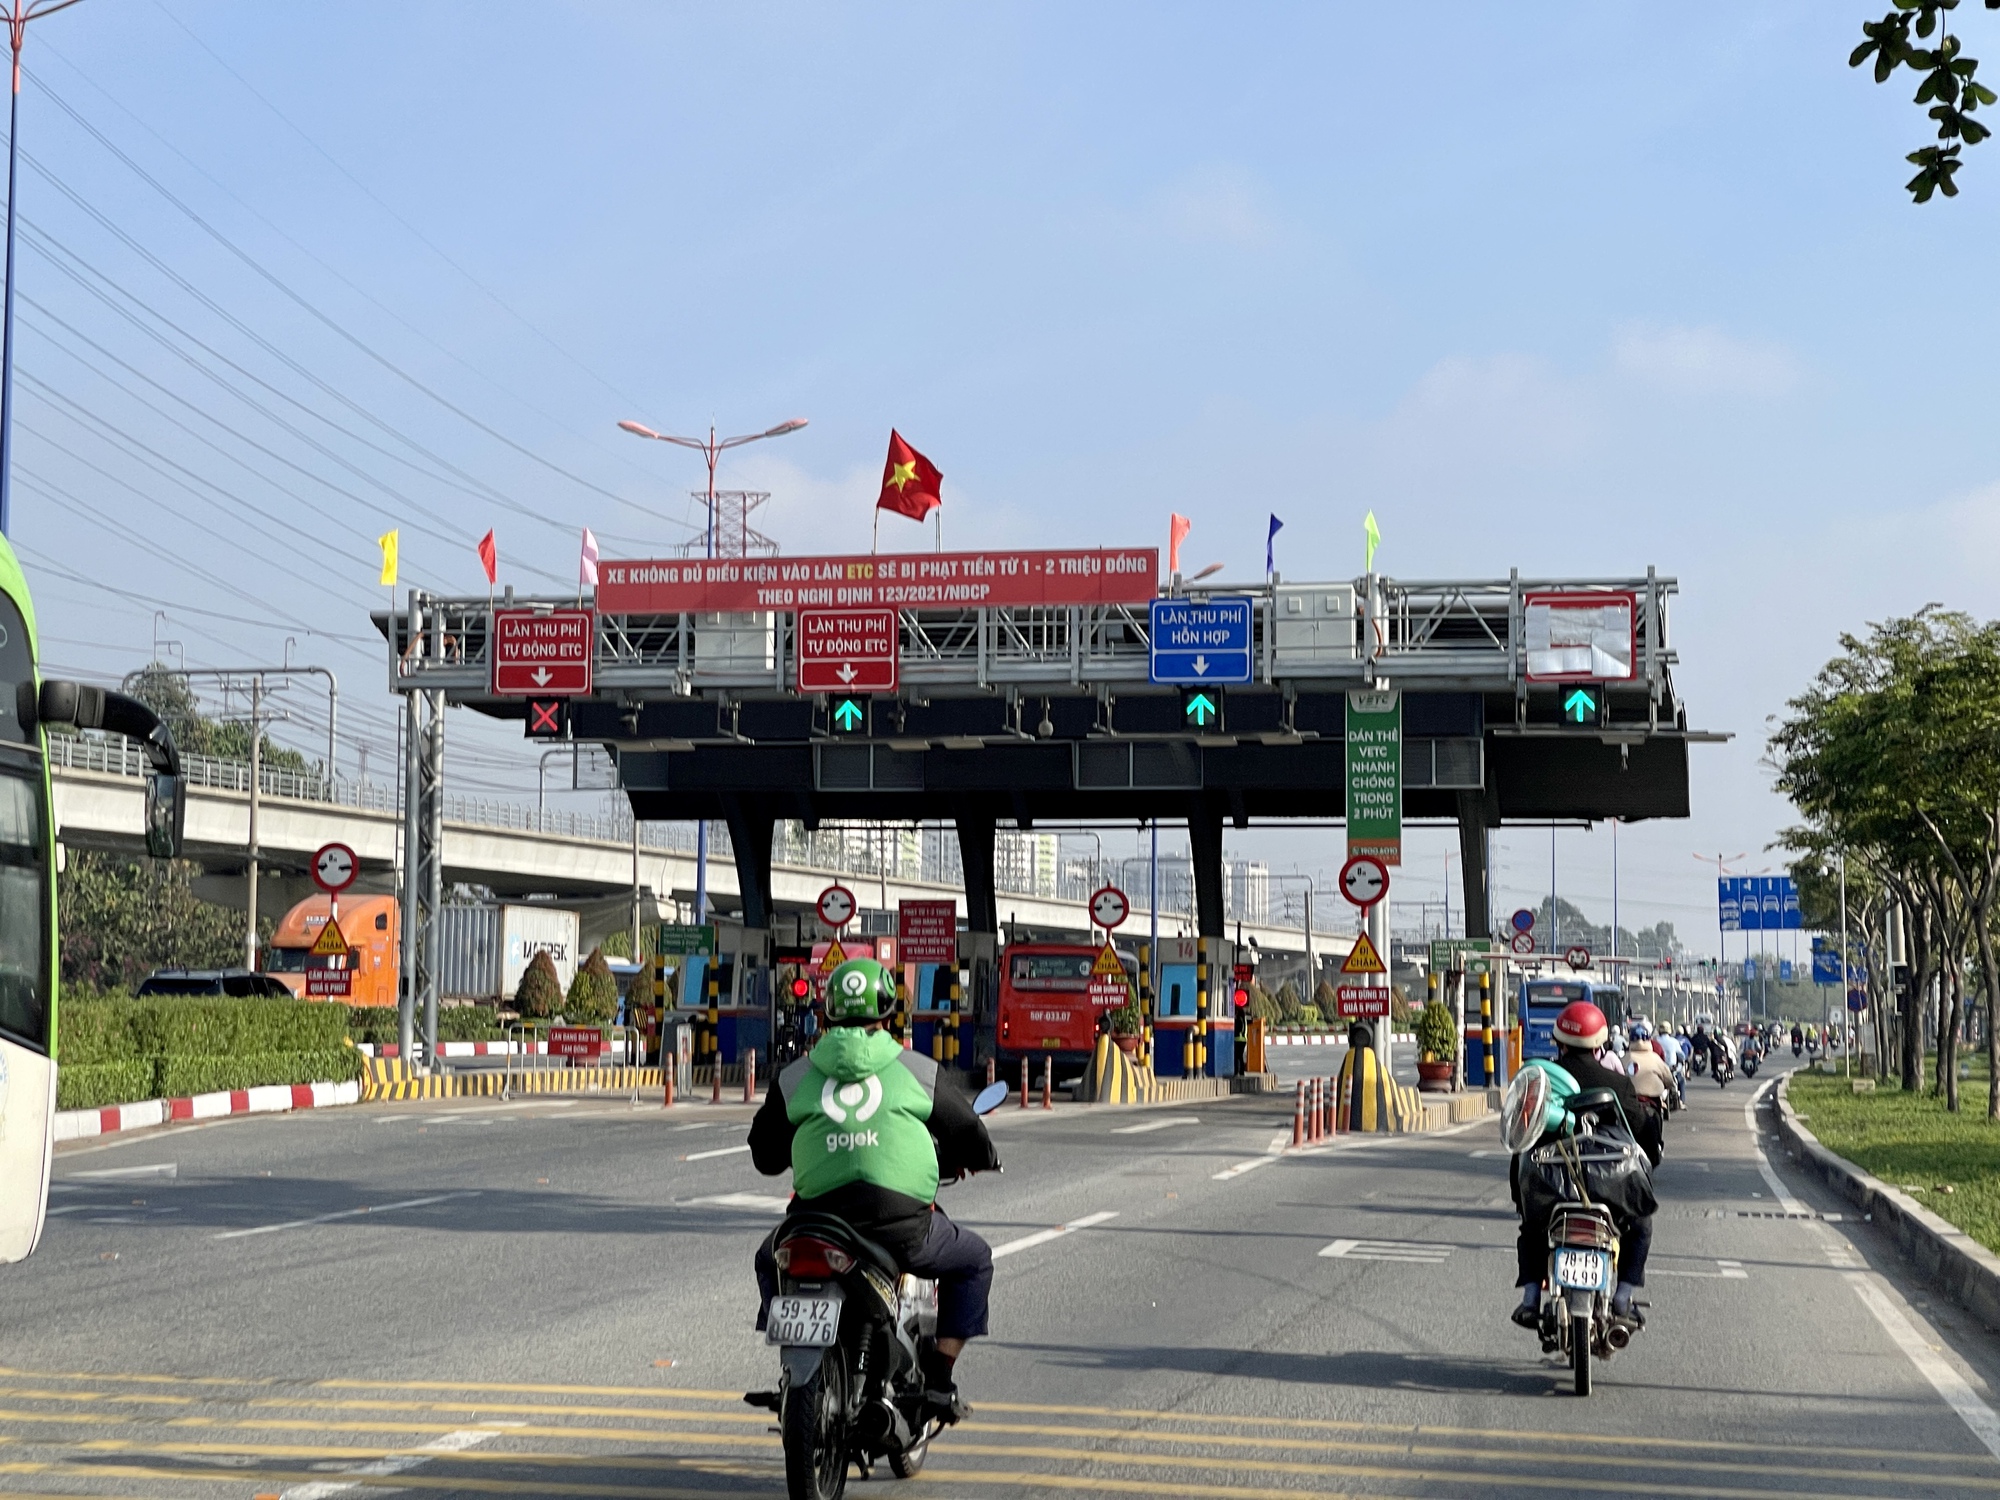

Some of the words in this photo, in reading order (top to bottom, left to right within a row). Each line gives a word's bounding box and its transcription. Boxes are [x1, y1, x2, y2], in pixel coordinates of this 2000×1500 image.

[607, 568, 626, 584] XE
[630, 564, 679, 584] KHÔNG
[744, 562, 778, 585] KIỆN
[782, 562, 810, 581] VÀO
[814, 561, 843, 580] LÀN
[847, 563, 874, 580] ETC
[878, 560, 896, 579] SẼ
[901, 562, 916, 581] BỊ
[920, 560, 958, 580] PHẠT
[1022, 559, 1029, 576] 1
[1046, 558, 1055, 575] 2
[1059, 554, 1100, 578] TRIỆU
[757, 588, 794, 605] THEO
[798, 588, 833, 607] NGHỊ
[837, 586, 873, 606] ĐỊNH
[1160, 607, 1187, 625] LÀN
[1190, 610, 1216, 624] THU
[1220, 606, 1242, 624] PHÍ
[505, 620, 530, 638] LÀN
[533, 623, 558, 638] THU
[560, 618, 582, 637] PHÍ
[808, 616, 834, 634] LÀN
[837, 618, 862, 633] THU
[866, 616, 887, 633] PHÍ
[806, 638, 824, 656] TỰ
[826, 636, 862, 656] ĐỘNG
[865, 638, 888, 653] ETC
[1204, 628, 1230, 646] HỢP
[504, 642, 520, 660] TỰ
[522, 640, 557, 659] ĐỘNG
[560, 642, 582, 657] ETC
[1359, 746, 1388, 758] VETC
[1352, 761, 1396, 773] NHANH
[1352, 774, 1396, 788] CHÓNG
[1354, 792, 1394, 804] TRONG
[1354, 808, 1360, 820] 2
[1364, 804, 1394, 820] PHÚT
[1178, 942, 1193, 958] 14
[826, 1129, 879, 1152] gojek
[1562, 1270, 1598, 1286] 9499
[780, 1300, 830, 1320] 59-X2
